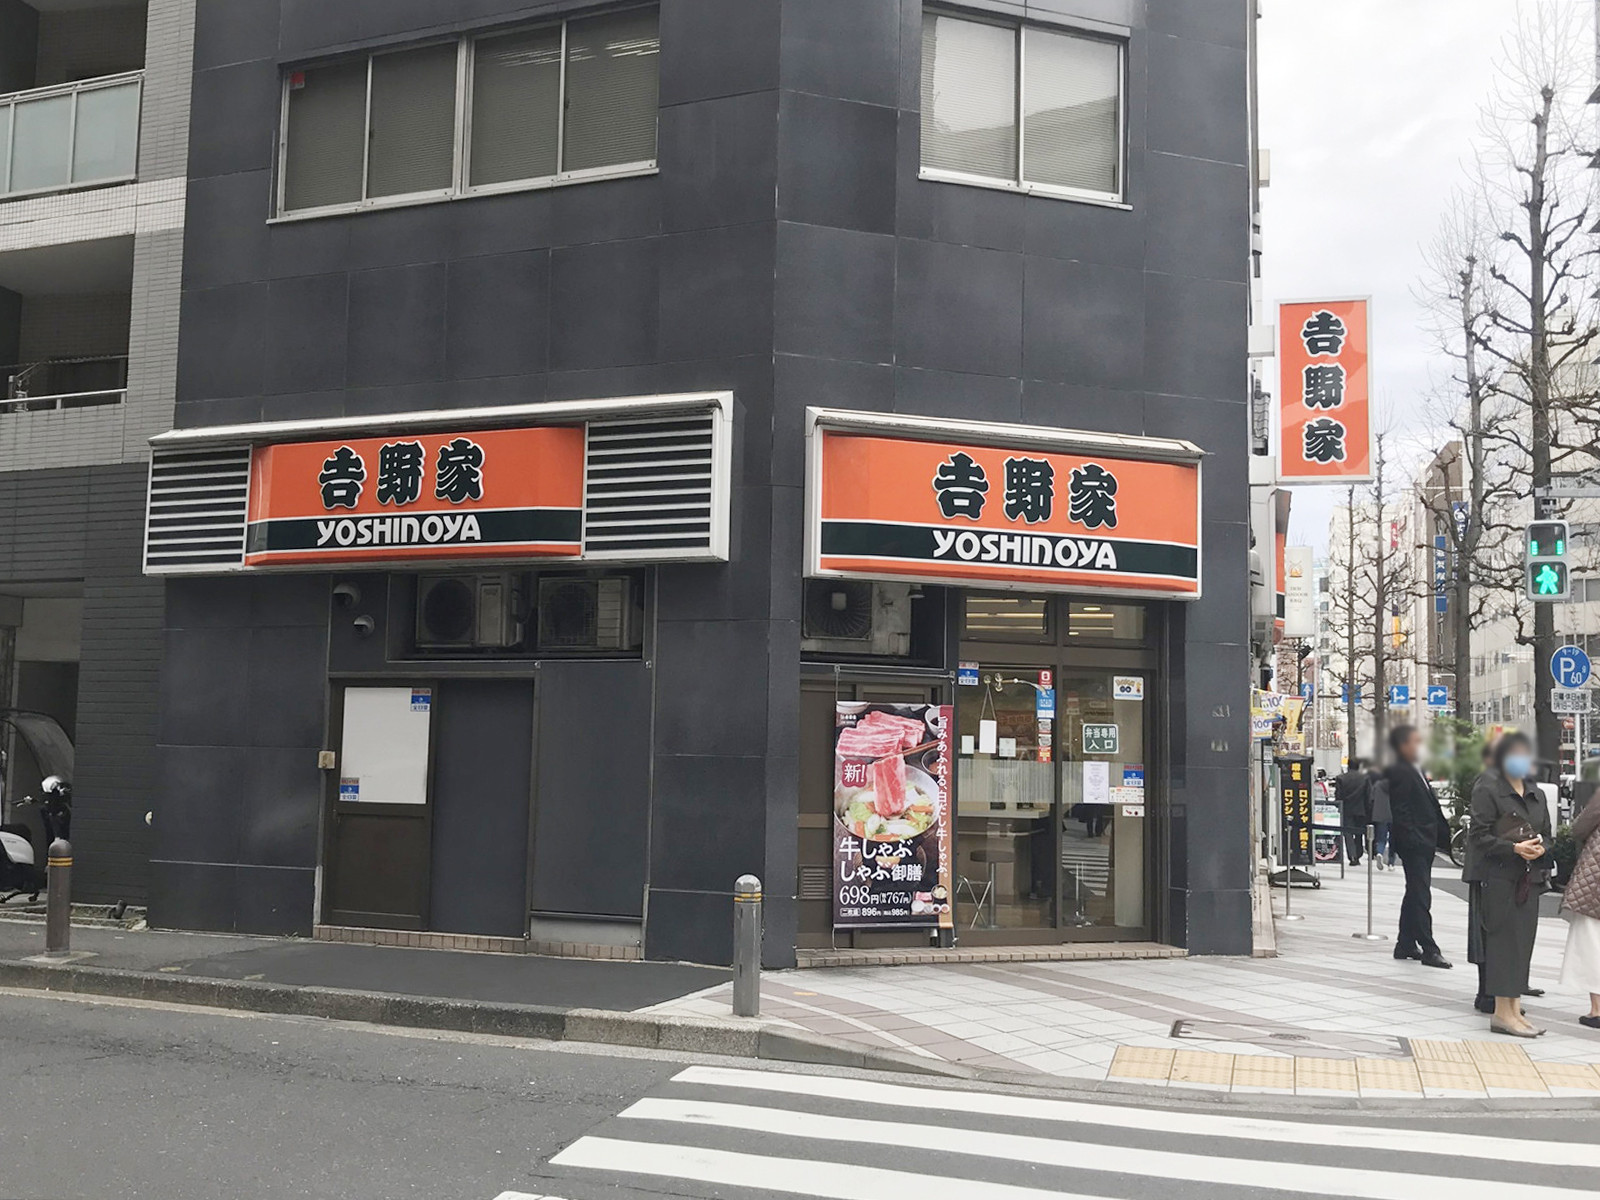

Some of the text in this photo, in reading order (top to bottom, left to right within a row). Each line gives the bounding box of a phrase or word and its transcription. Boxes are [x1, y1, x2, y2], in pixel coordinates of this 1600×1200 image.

[1300, 308, 1348, 465] 吉野家
[316, 437, 486, 511] 吉野家
[932, 450, 1120, 531] 吉野家
[316, 513, 481, 547] YOSHINOYA
[932, 529, 1117, 570] YOSHINOYA
[1559, 657, 1576, 684] P
[1085, 728, 1116, 738] 弁当専用
[1088, 740, 1114, 750] 入口
[839, 836, 913, 861] 牛しゃぶ
[840, 860, 923, 882] しゃぶ御膳
